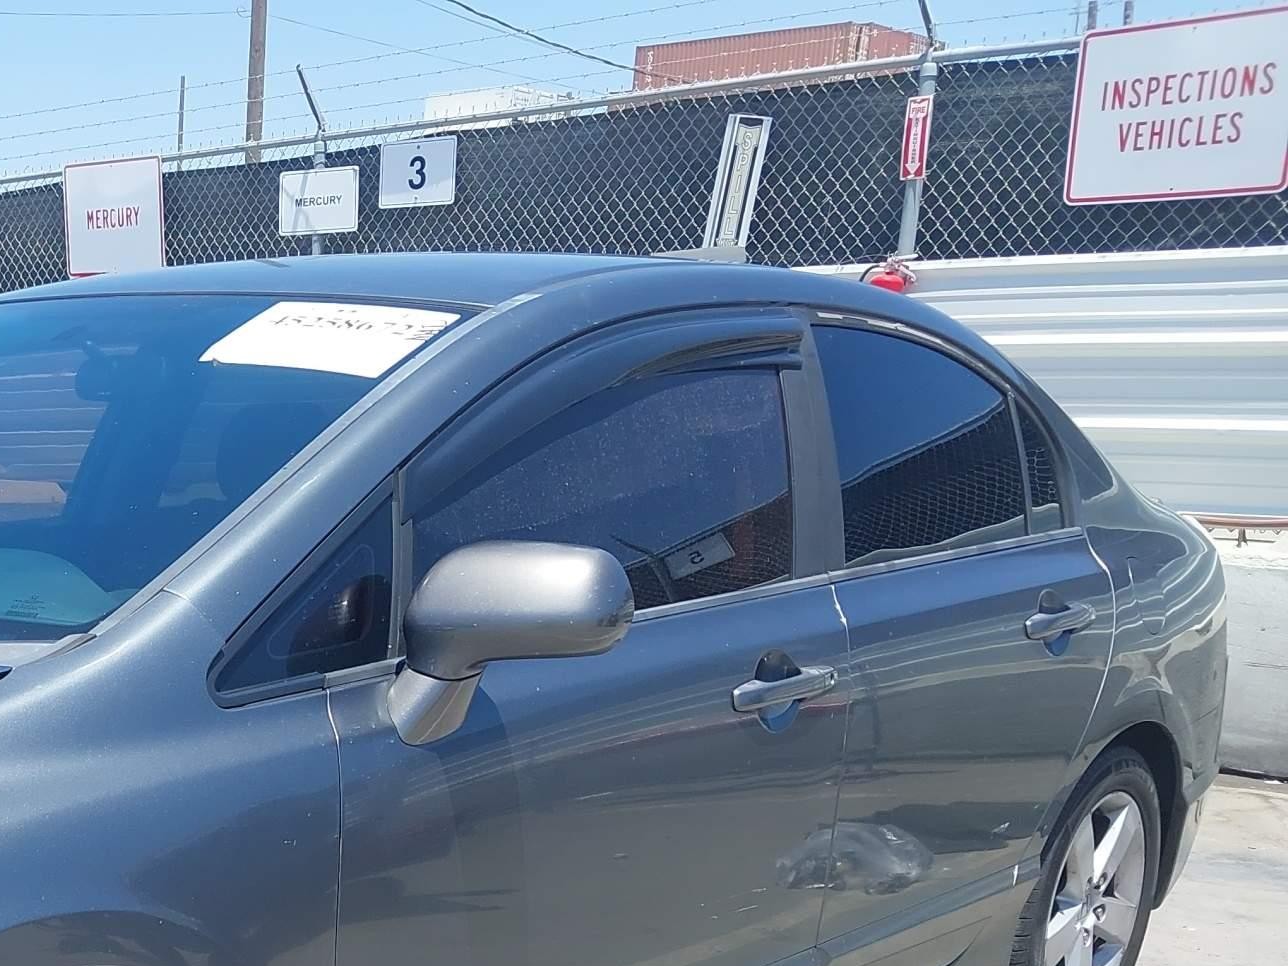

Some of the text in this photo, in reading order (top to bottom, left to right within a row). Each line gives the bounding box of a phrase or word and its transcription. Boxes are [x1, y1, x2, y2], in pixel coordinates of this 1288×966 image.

[1101, 62, 1277, 112] INSPECTIONS
[911, 106, 926, 115] FIRE
[1118, 111, 1244, 152] VEHICLES
[407, 155, 426, 190] 3
[723, 132, 753, 236] SPILL
[86, 206, 141, 231] MERCURY
[294, 194, 343, 208] MERCURY
